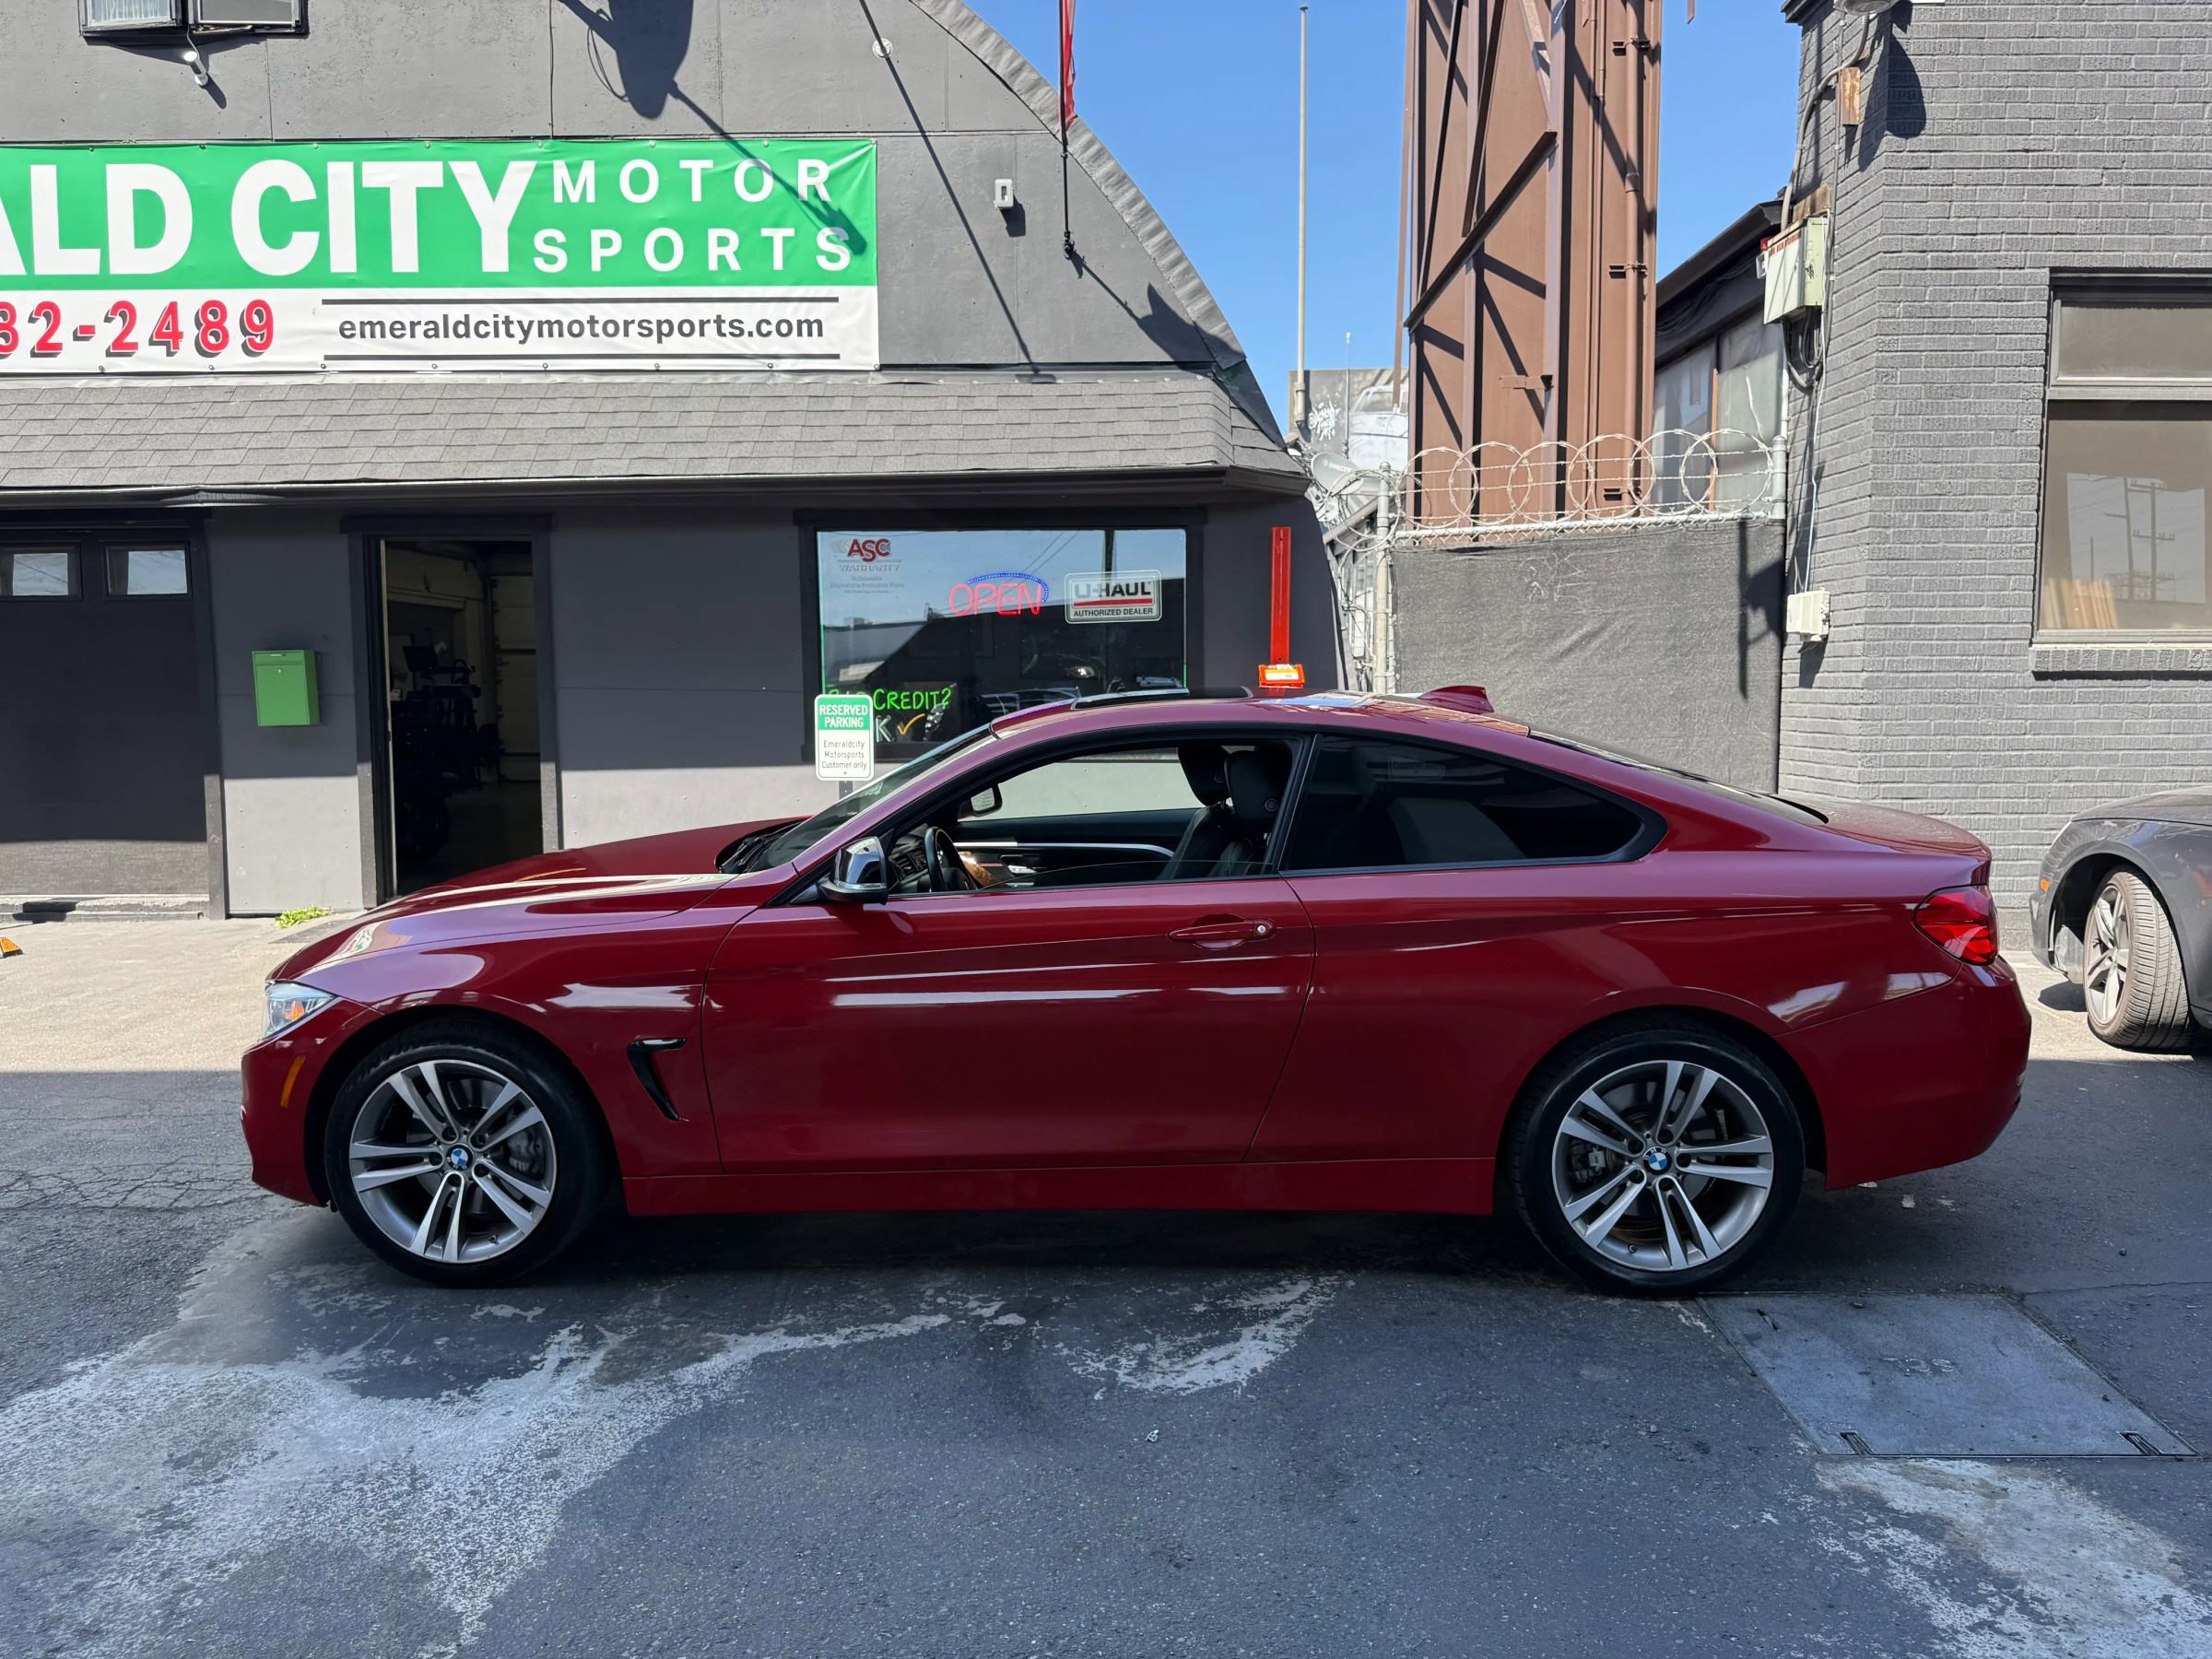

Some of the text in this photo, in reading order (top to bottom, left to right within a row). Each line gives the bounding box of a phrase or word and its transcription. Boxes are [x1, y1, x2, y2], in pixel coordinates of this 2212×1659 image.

[553, 158, 831, 204] MOTOR
[0, 159, 537, 276] LD CITY
[533, 227, 851, 273] SPORTS
[338, 312, 824, 345] emeraldcitymotorsports.com
[846, 538, 891, 563] ASC
[949, 582, 1042, 617] OPEN
[1074, 581, 1152, 598] U-HAUL
[1073, 607, 1154, 618] AUTHORIZED DEALER
[873, 688, 952, 711] CREDIT?
[819, 704, 868, 716] RESERVED
[824, 716, 865, 728] PARKING
[823, 739, 865, 749] Emeraldcity
[824, 750, 865, 760] Motorsports
[821, 760, 867, 771] Customer only
